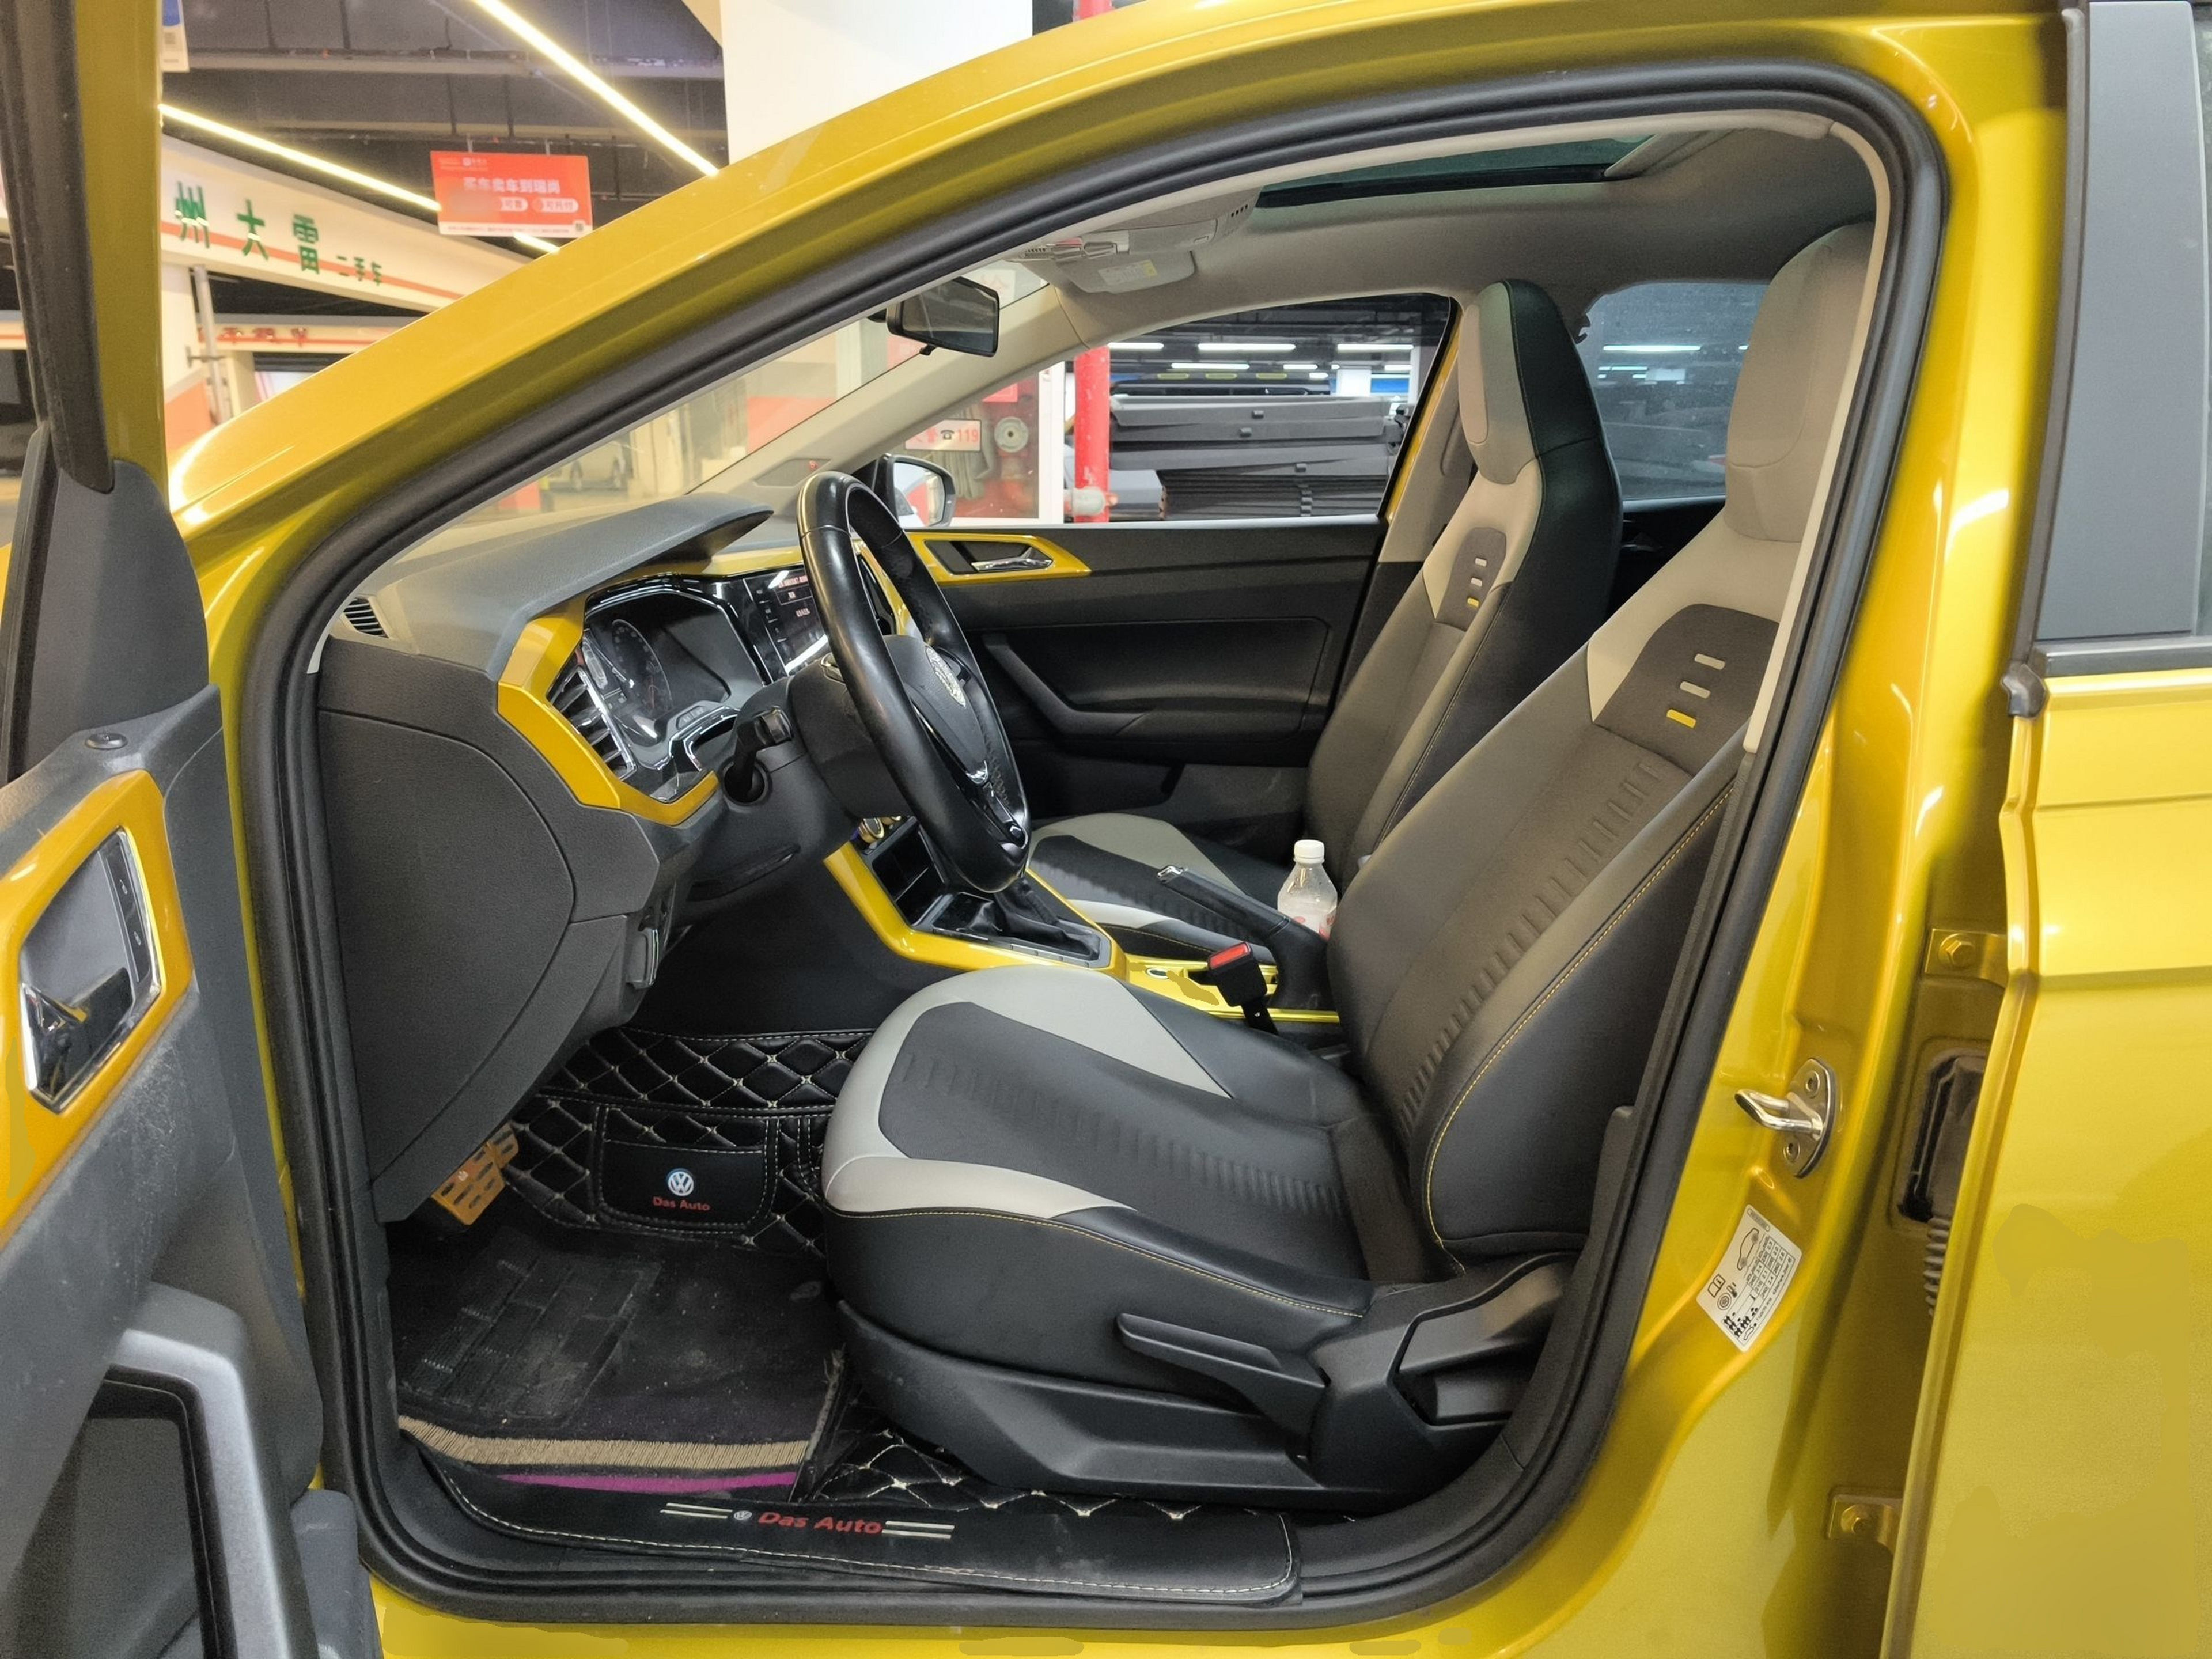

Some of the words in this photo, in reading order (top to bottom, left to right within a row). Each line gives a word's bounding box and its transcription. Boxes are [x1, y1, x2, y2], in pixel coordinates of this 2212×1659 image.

[957, 428, 979, 443] 119
[652, 1196, 676, 1209] Das
[680, 1199, 711, 1211] Auto
[758, 1511, 808, 1528] Das
[813, 1516, 884, 1535] Auto
